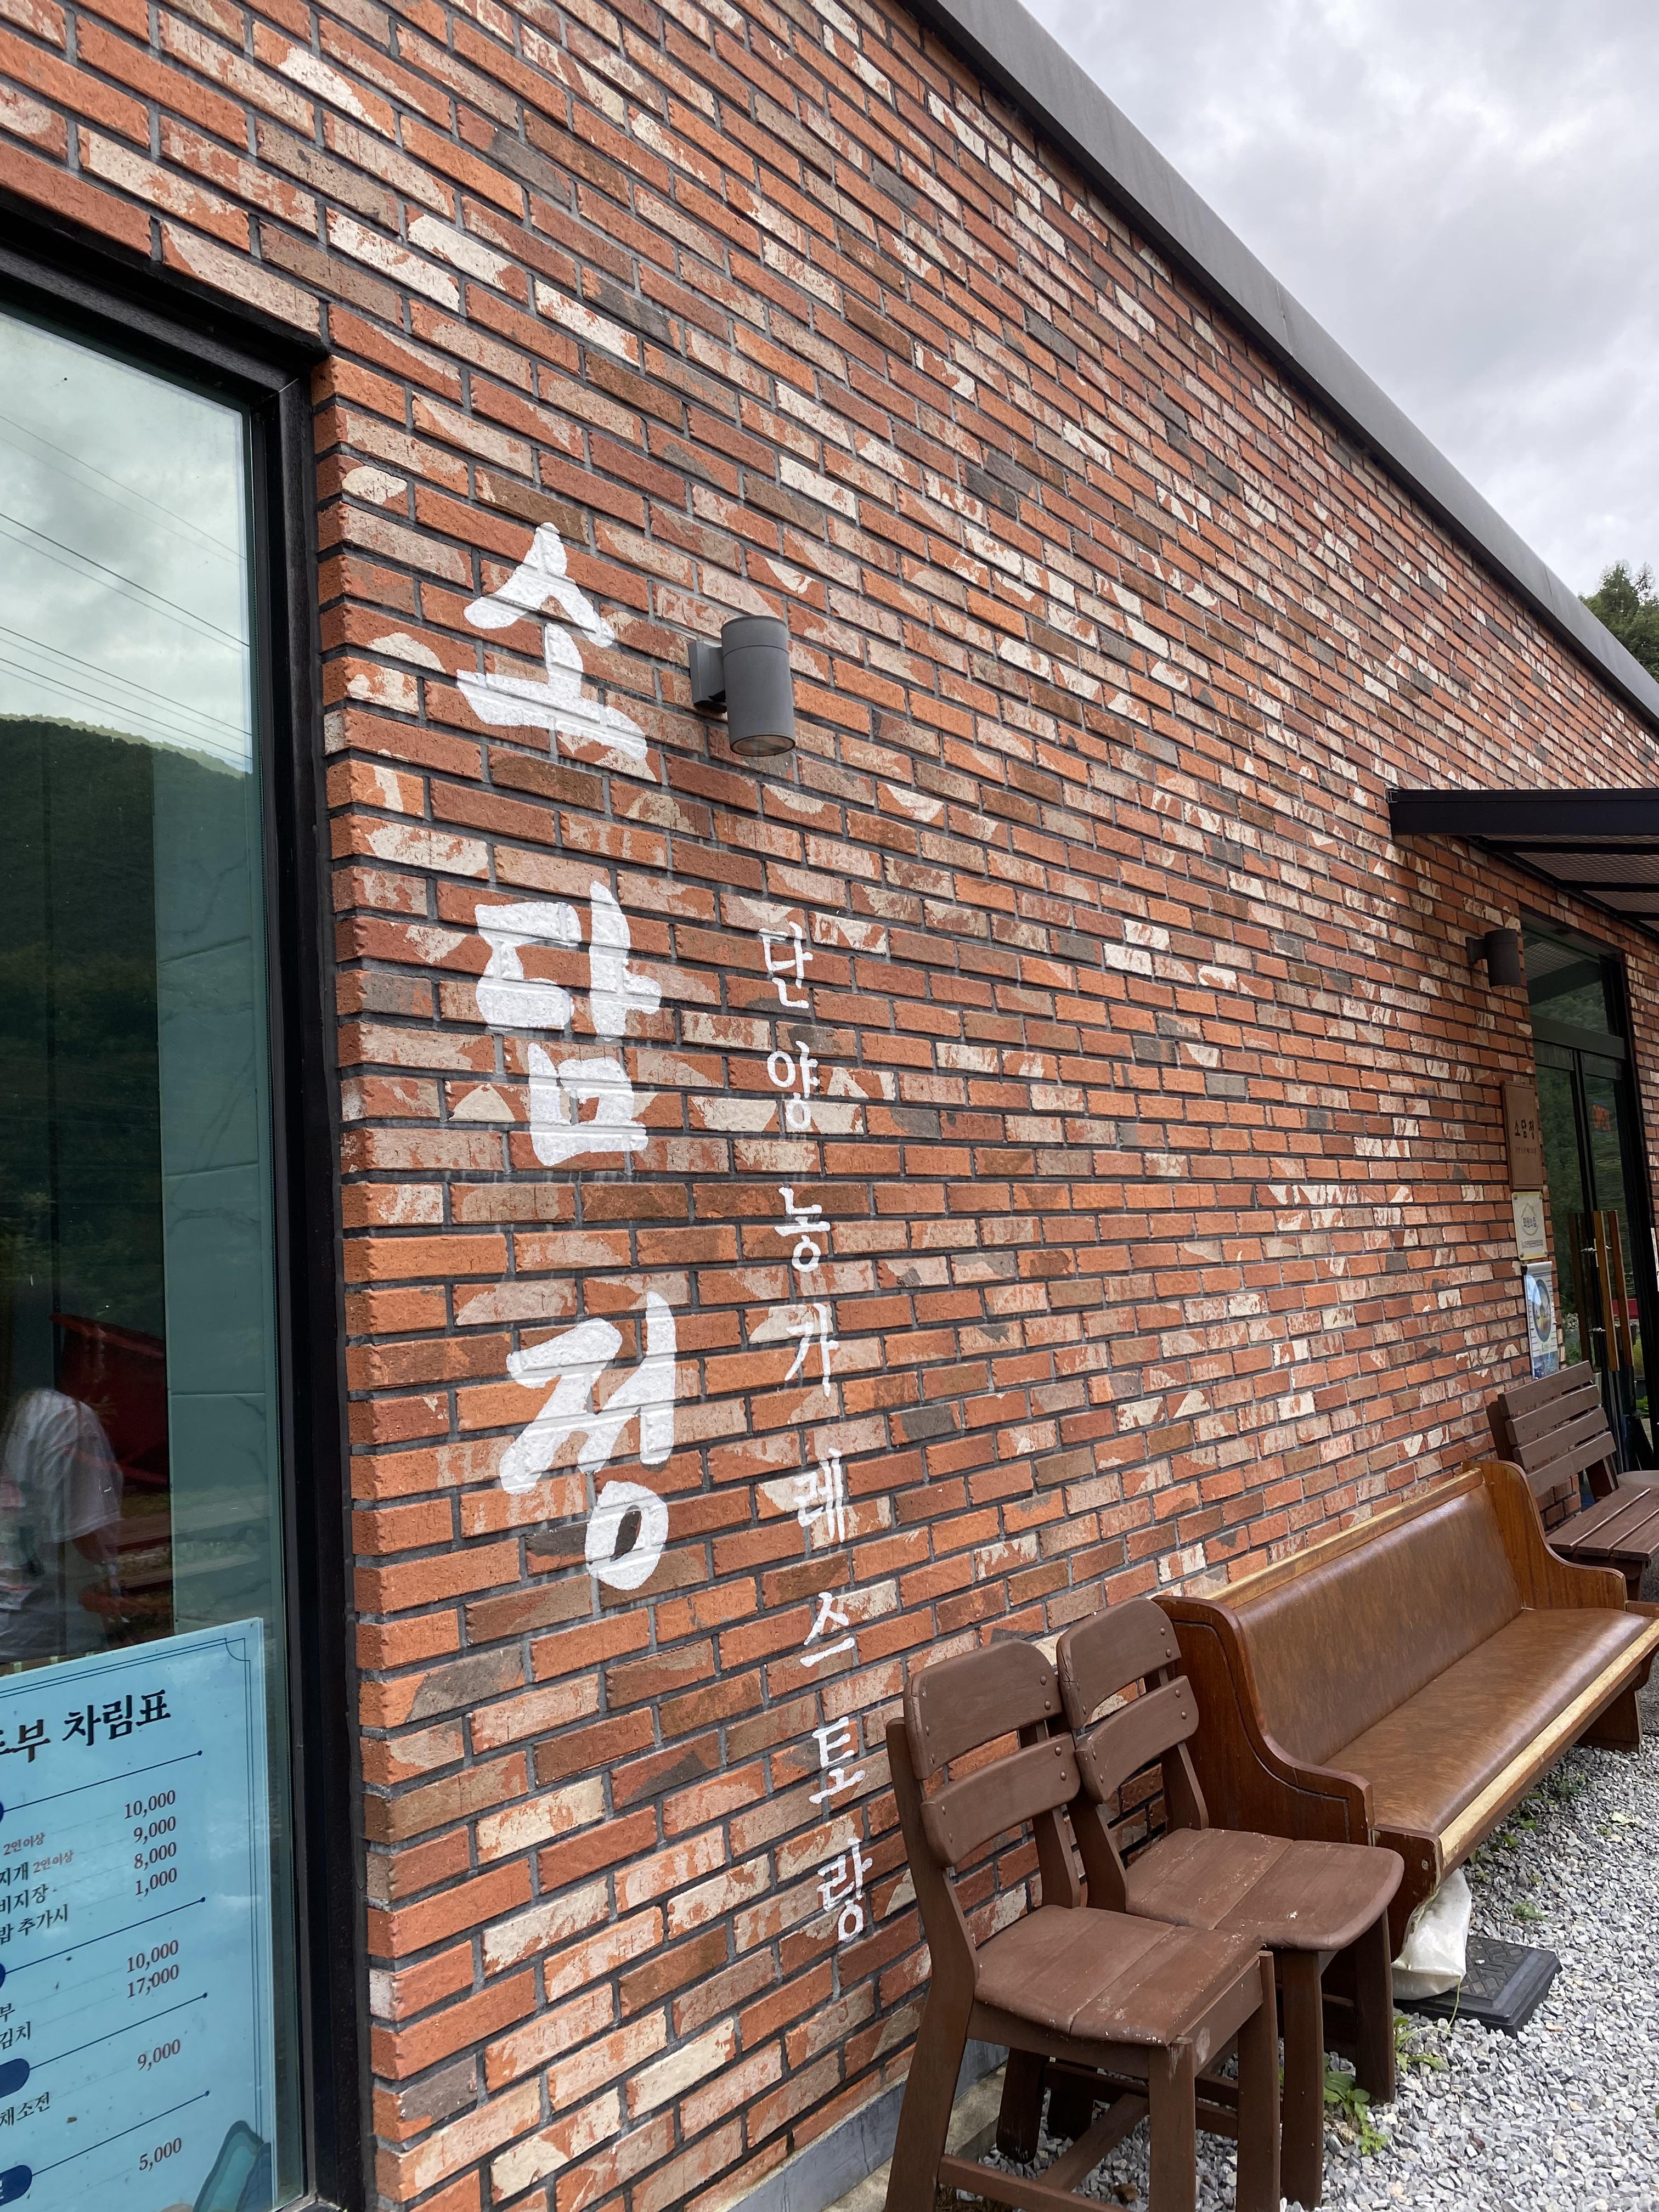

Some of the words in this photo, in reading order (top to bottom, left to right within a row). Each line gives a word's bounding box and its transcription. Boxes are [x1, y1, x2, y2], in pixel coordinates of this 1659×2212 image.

[457, 521, 676, 1590] 소담정
[1515, 1118, 1534, 1139] 소담정
[62, 1689, 171, 1746] 차림표
[124, 1790, 176, 1819] 10,000
[133, 1816, 176, 1844] 9,000
[134, 1842, 177, 1870] 8,000
[18, 1904, 68, 1936] 추가시
[136, 1867, 177, 1897] 1,000
[127, 1940, 178, 1973] 10,000
[0, 2022, 30, 2050] 김치
[127, 1964, 179, 1998] 17,000
[138, 2039, 180, 2071] 9,000
[139, 2137, 182, 2171] 5,000
